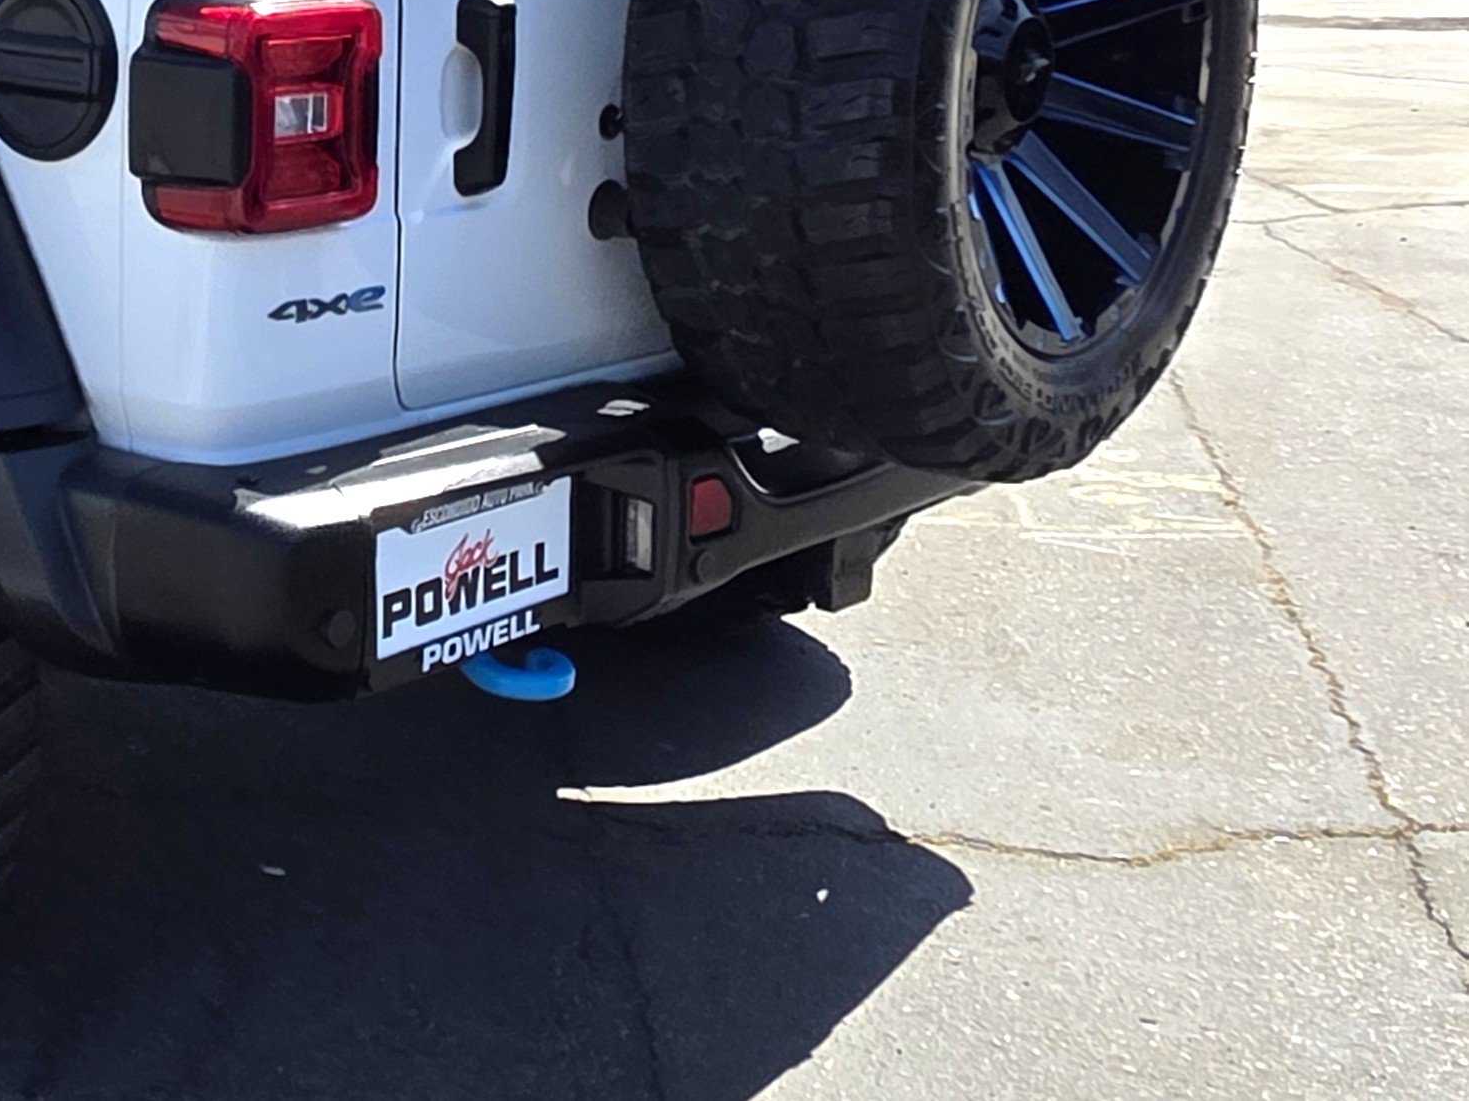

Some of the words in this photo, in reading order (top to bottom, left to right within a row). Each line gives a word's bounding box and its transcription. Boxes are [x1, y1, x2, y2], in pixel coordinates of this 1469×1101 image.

[267, 285, 386, 324] 4xe
[383, 542, 559, 639] POWELL
[444, 528, 499, 601] Jack
[422, 610, 541, 673] POWELL
